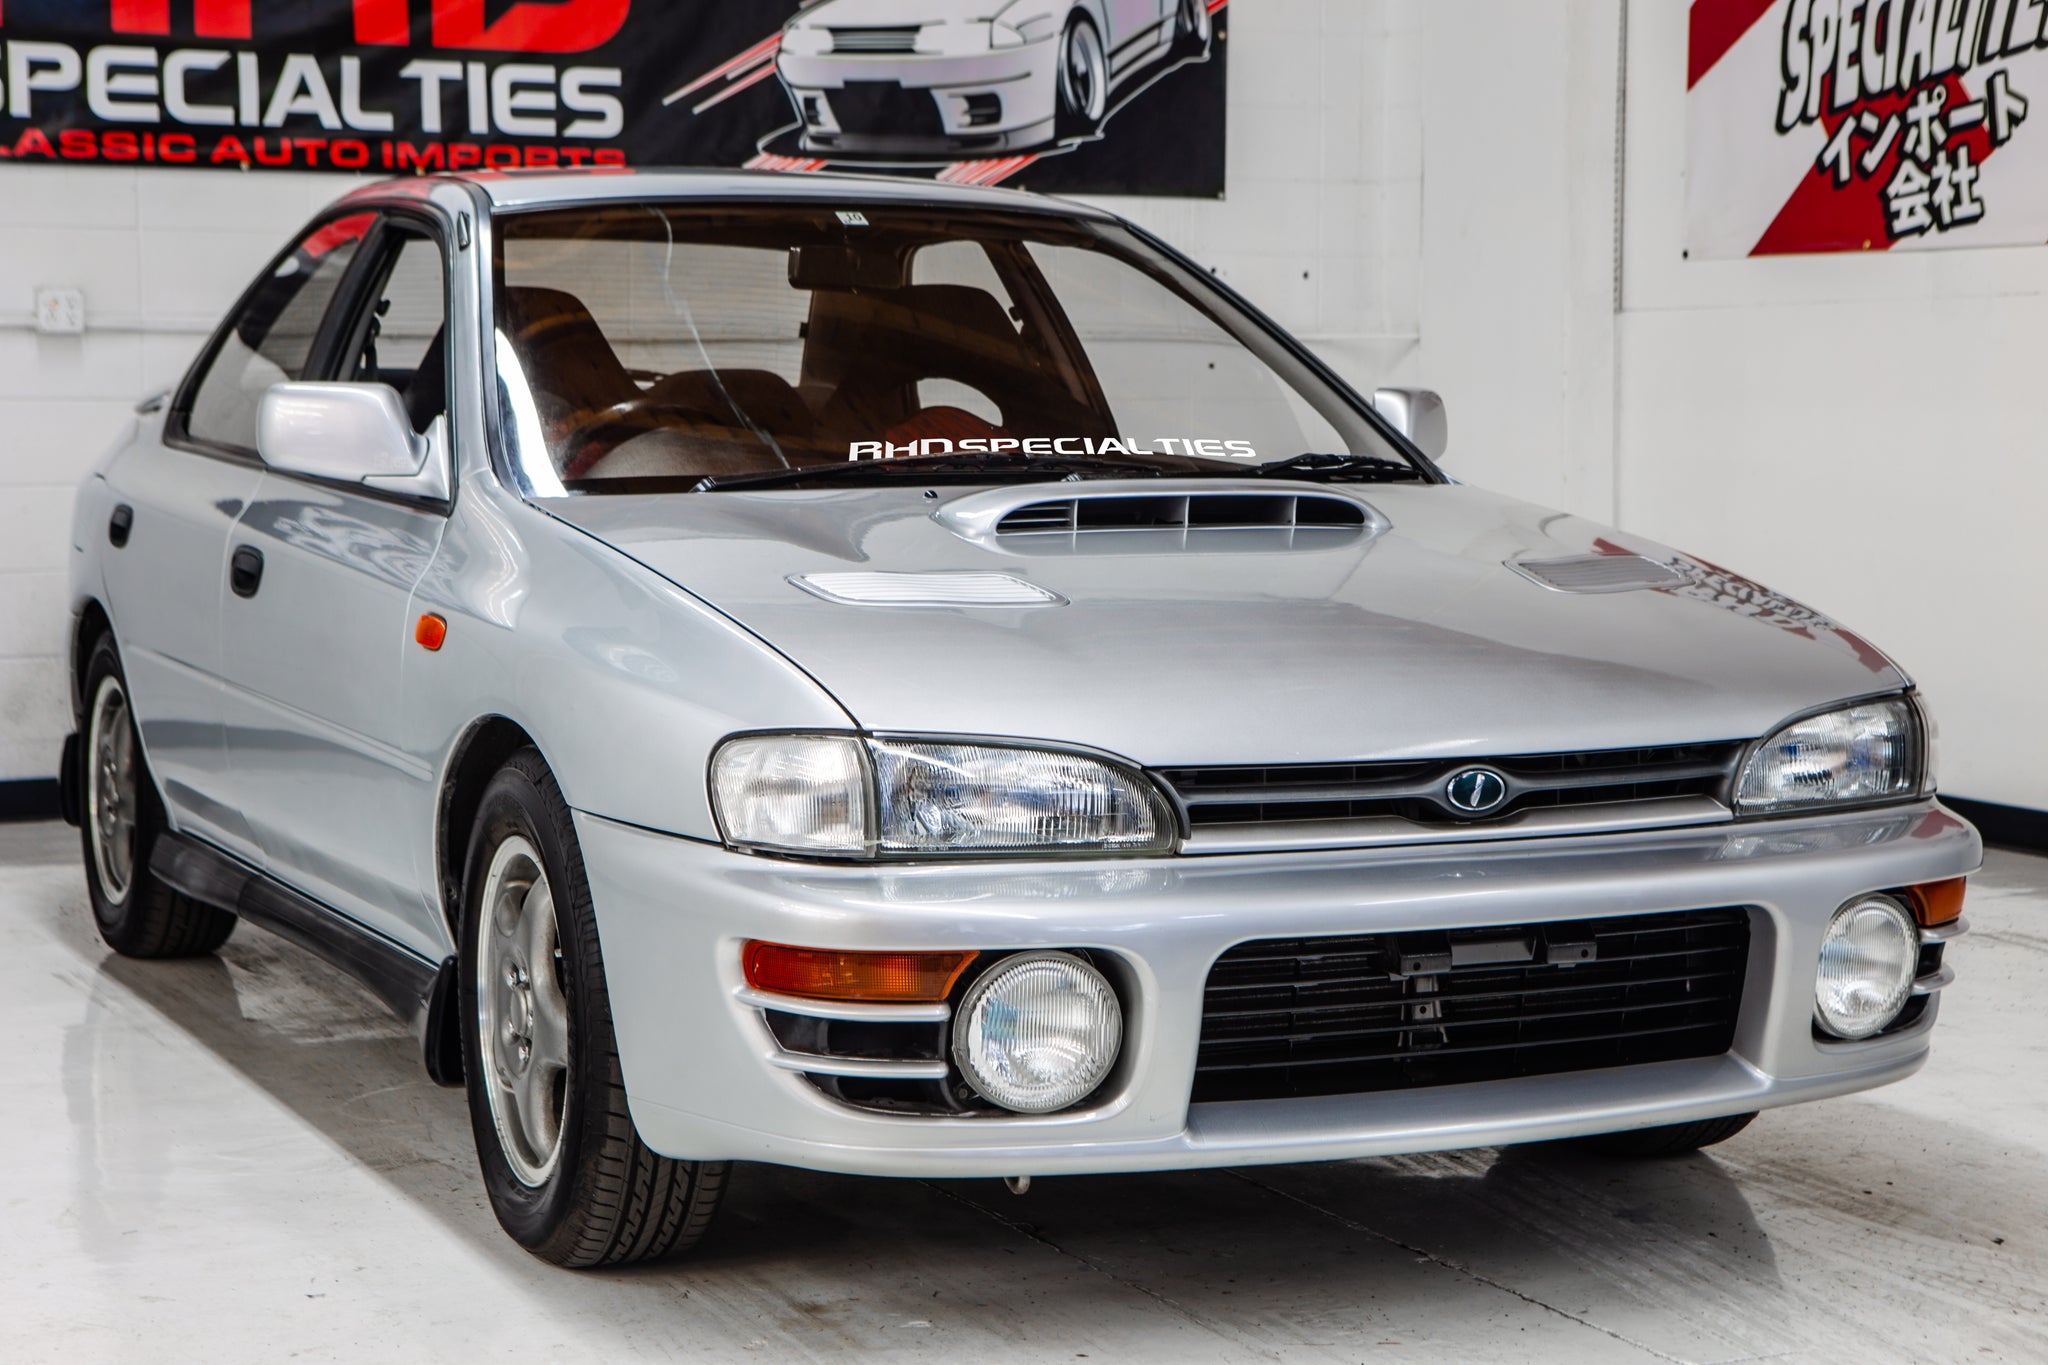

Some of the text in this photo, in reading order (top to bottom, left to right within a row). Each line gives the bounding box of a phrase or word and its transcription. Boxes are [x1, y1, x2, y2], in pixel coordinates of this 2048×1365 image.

[0, 39, 625, 139] PECIALTIES
[1816, 68, 2028, 191] インポート
[210, 135, 369, 168] AUTO
[382, 141, 626, 170] IMPORTS
[1878, 140, 1985, 240] 会社
